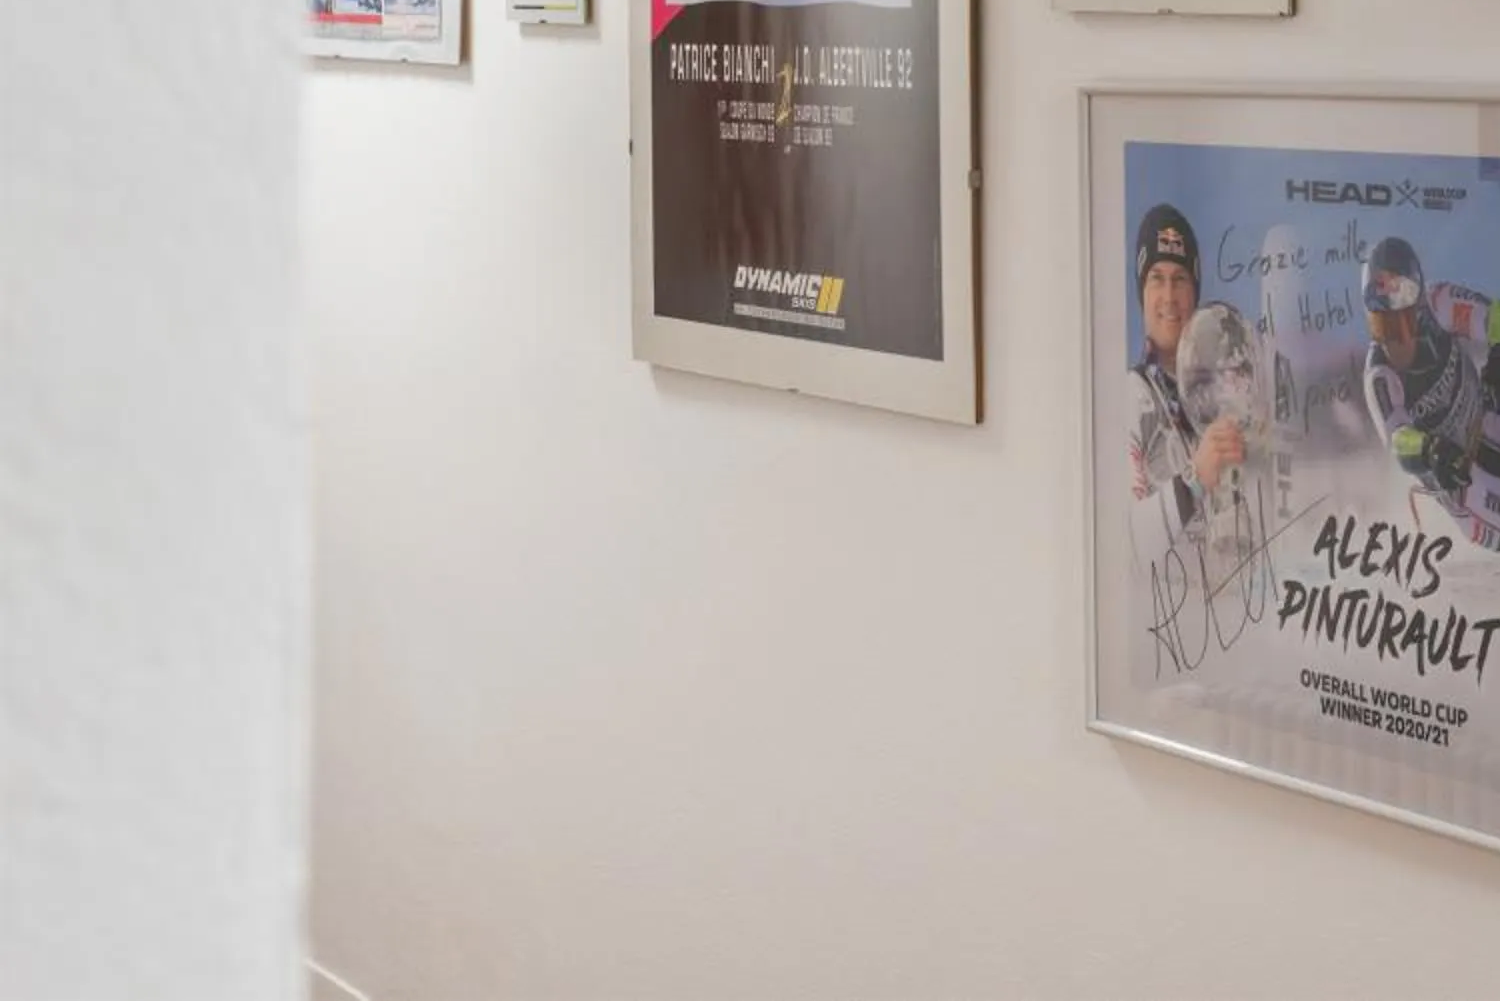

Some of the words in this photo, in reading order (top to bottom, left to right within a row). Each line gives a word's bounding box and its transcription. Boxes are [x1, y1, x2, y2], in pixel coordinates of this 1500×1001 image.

[669, 43, 718, 82] PATRICE
[723, 44, 775, 84] BIANCHI
[819, 46, 893, 88] ALBERTVILLE
[897, 48, 912, 90] 92
[1285, 179, 1393, 208] HEAD
[1216, 224, 1311, 283] Grazie
[1324, 219, 1369, 267] mille
[733, 264, 822, 298] DYNAMIC
[1297, 288, 1354, 334] Hotel
[1313, 515, 1454, 599] ALEXIS
[1300, 668, 1369, 703] OVERALL
[1370, 686, 1433, 718] WORLD
[1435, 703, 1469, 728] CUP
[1320, 696, 1383, 730] WINNER
[1384, 713, 1450, 748] 2020/21
